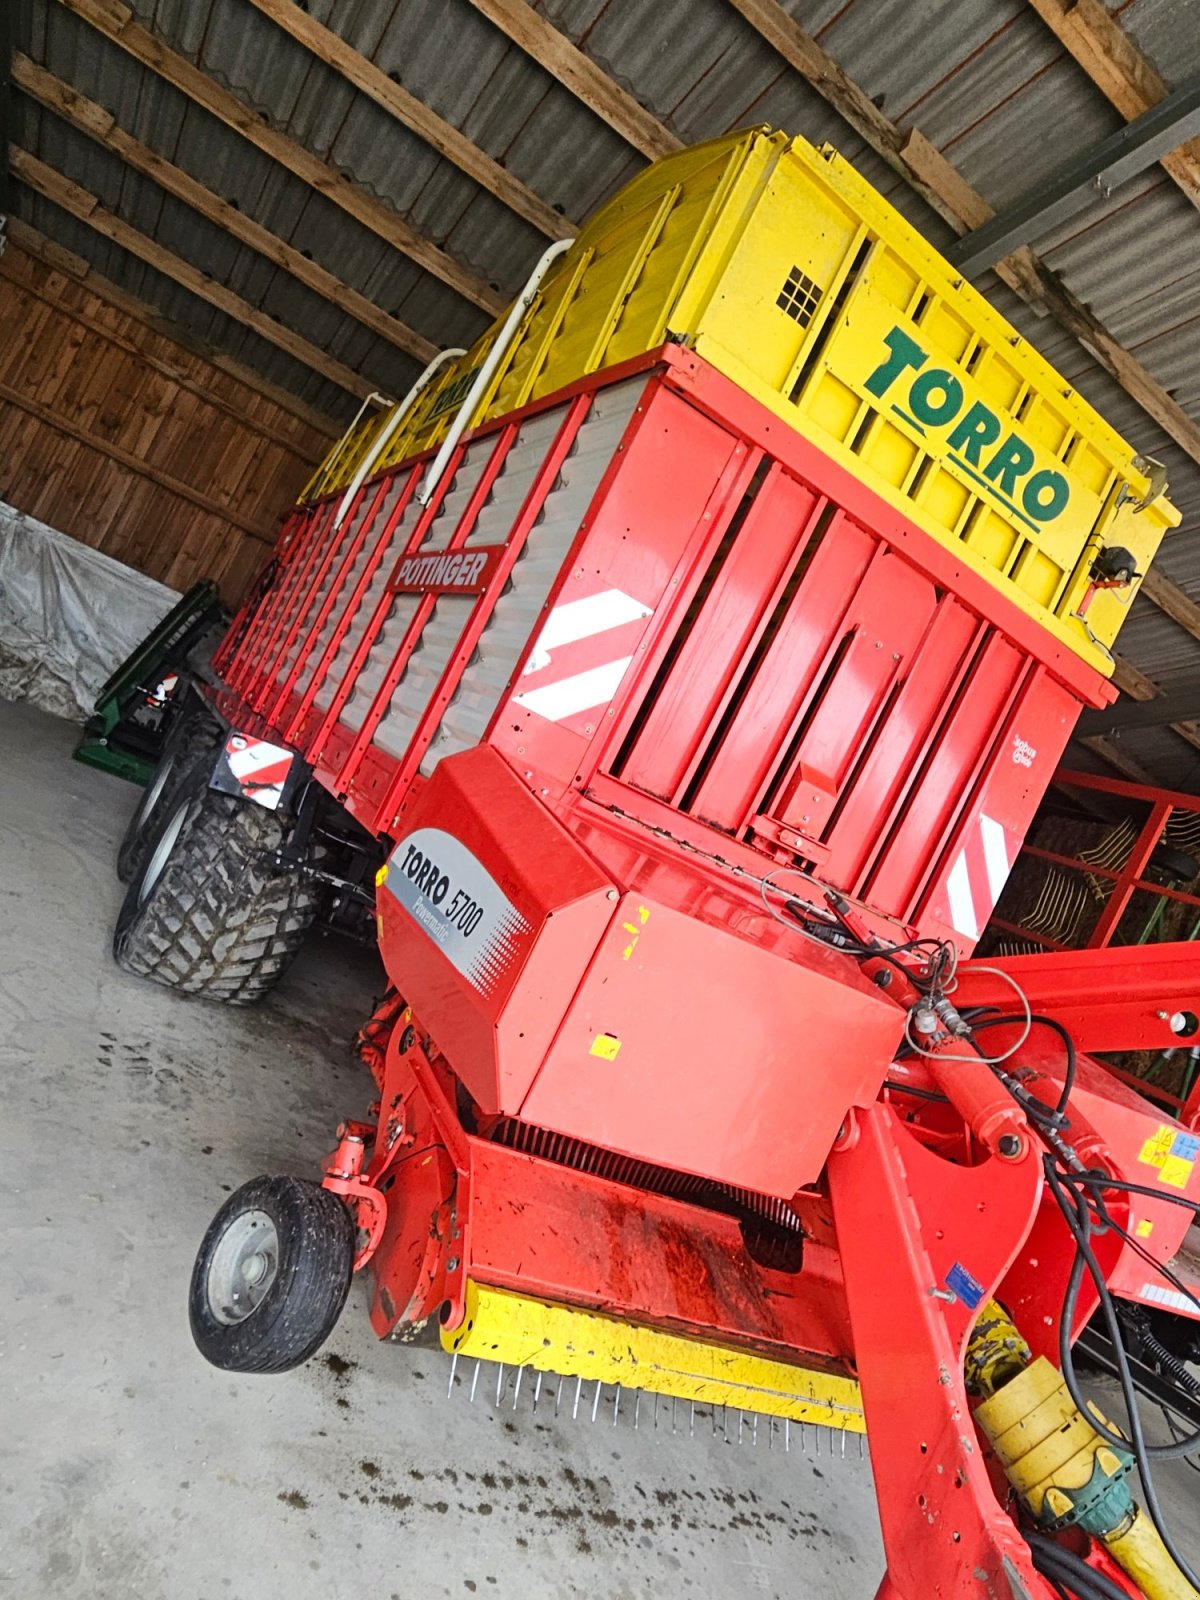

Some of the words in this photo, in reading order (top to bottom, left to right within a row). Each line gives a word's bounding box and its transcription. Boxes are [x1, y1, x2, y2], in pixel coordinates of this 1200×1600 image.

[862, 325, 1070, 522] TORRO
[401, 843, 450, 906] TORRO
[445, 889, 484, 938] 5700
